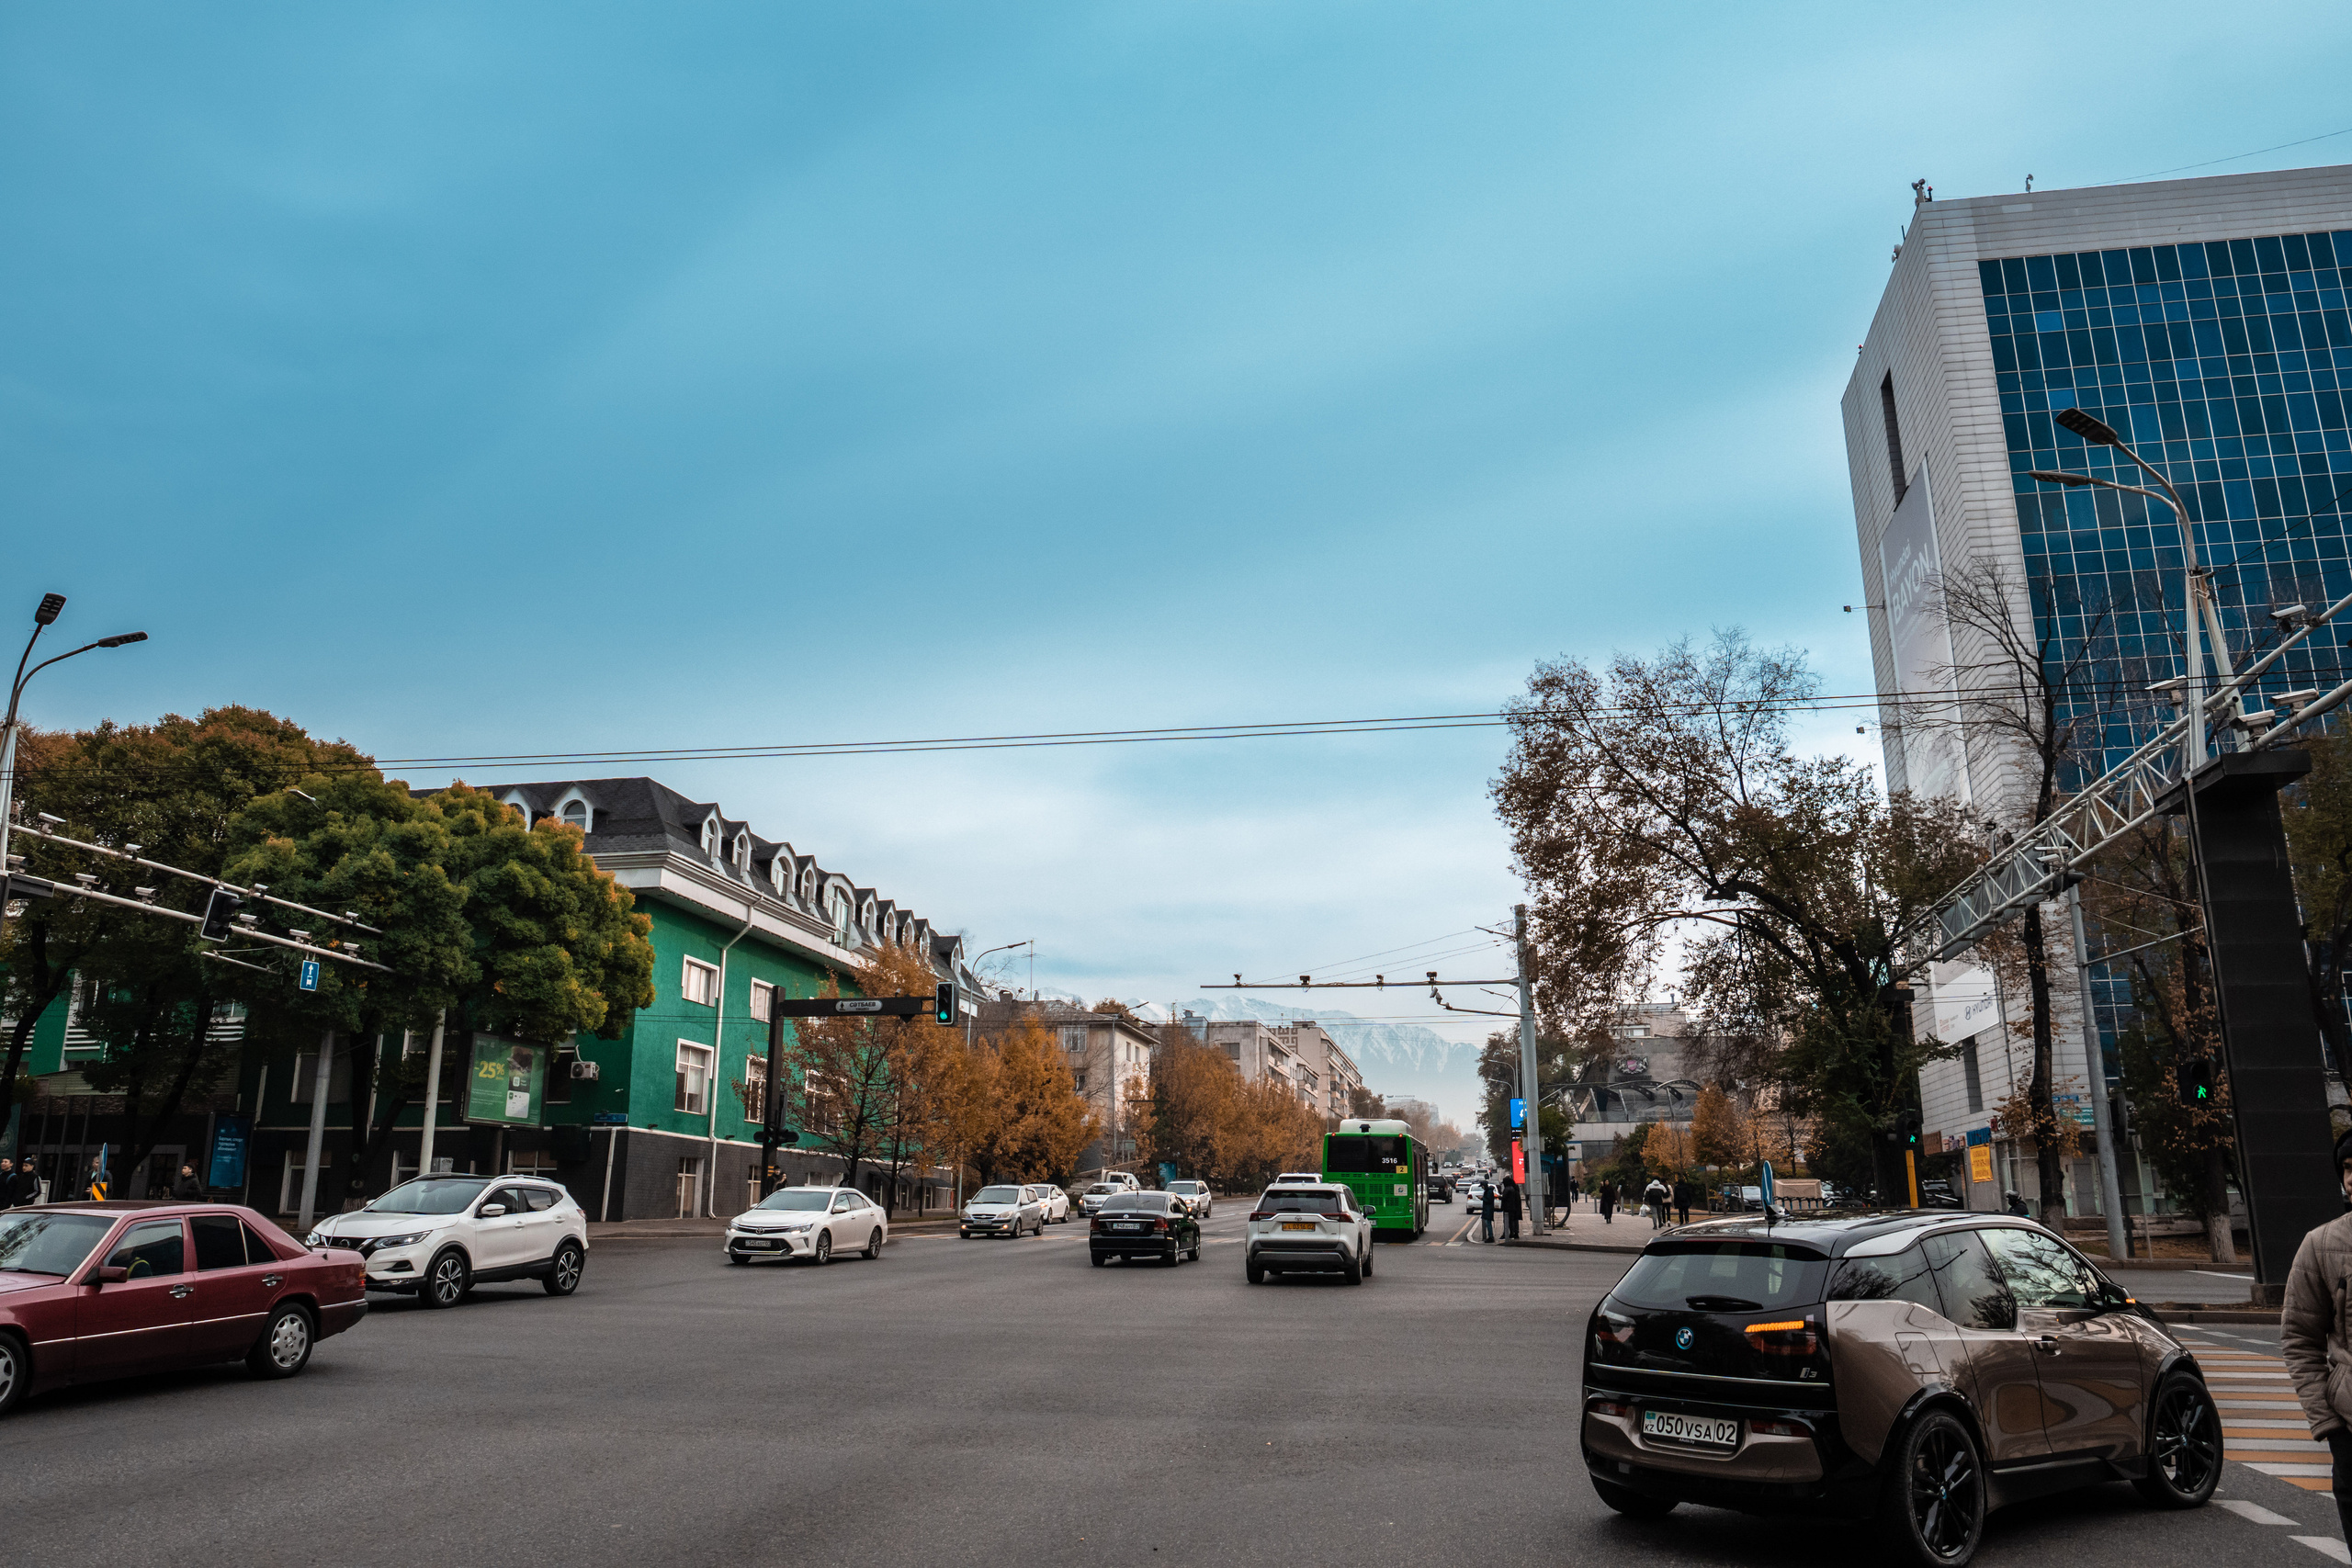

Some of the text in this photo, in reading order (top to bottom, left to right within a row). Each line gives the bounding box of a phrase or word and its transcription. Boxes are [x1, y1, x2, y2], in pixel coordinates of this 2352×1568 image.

[1889, 538, 1911, 587] Hyundai
[1893, 542, 1933, 625] BAYON.
[474, 1060, 505, 1079] -25%
[1645, 1423, 1655, 1433] KZ
[1716, 1422, 1736, 1443] 02
